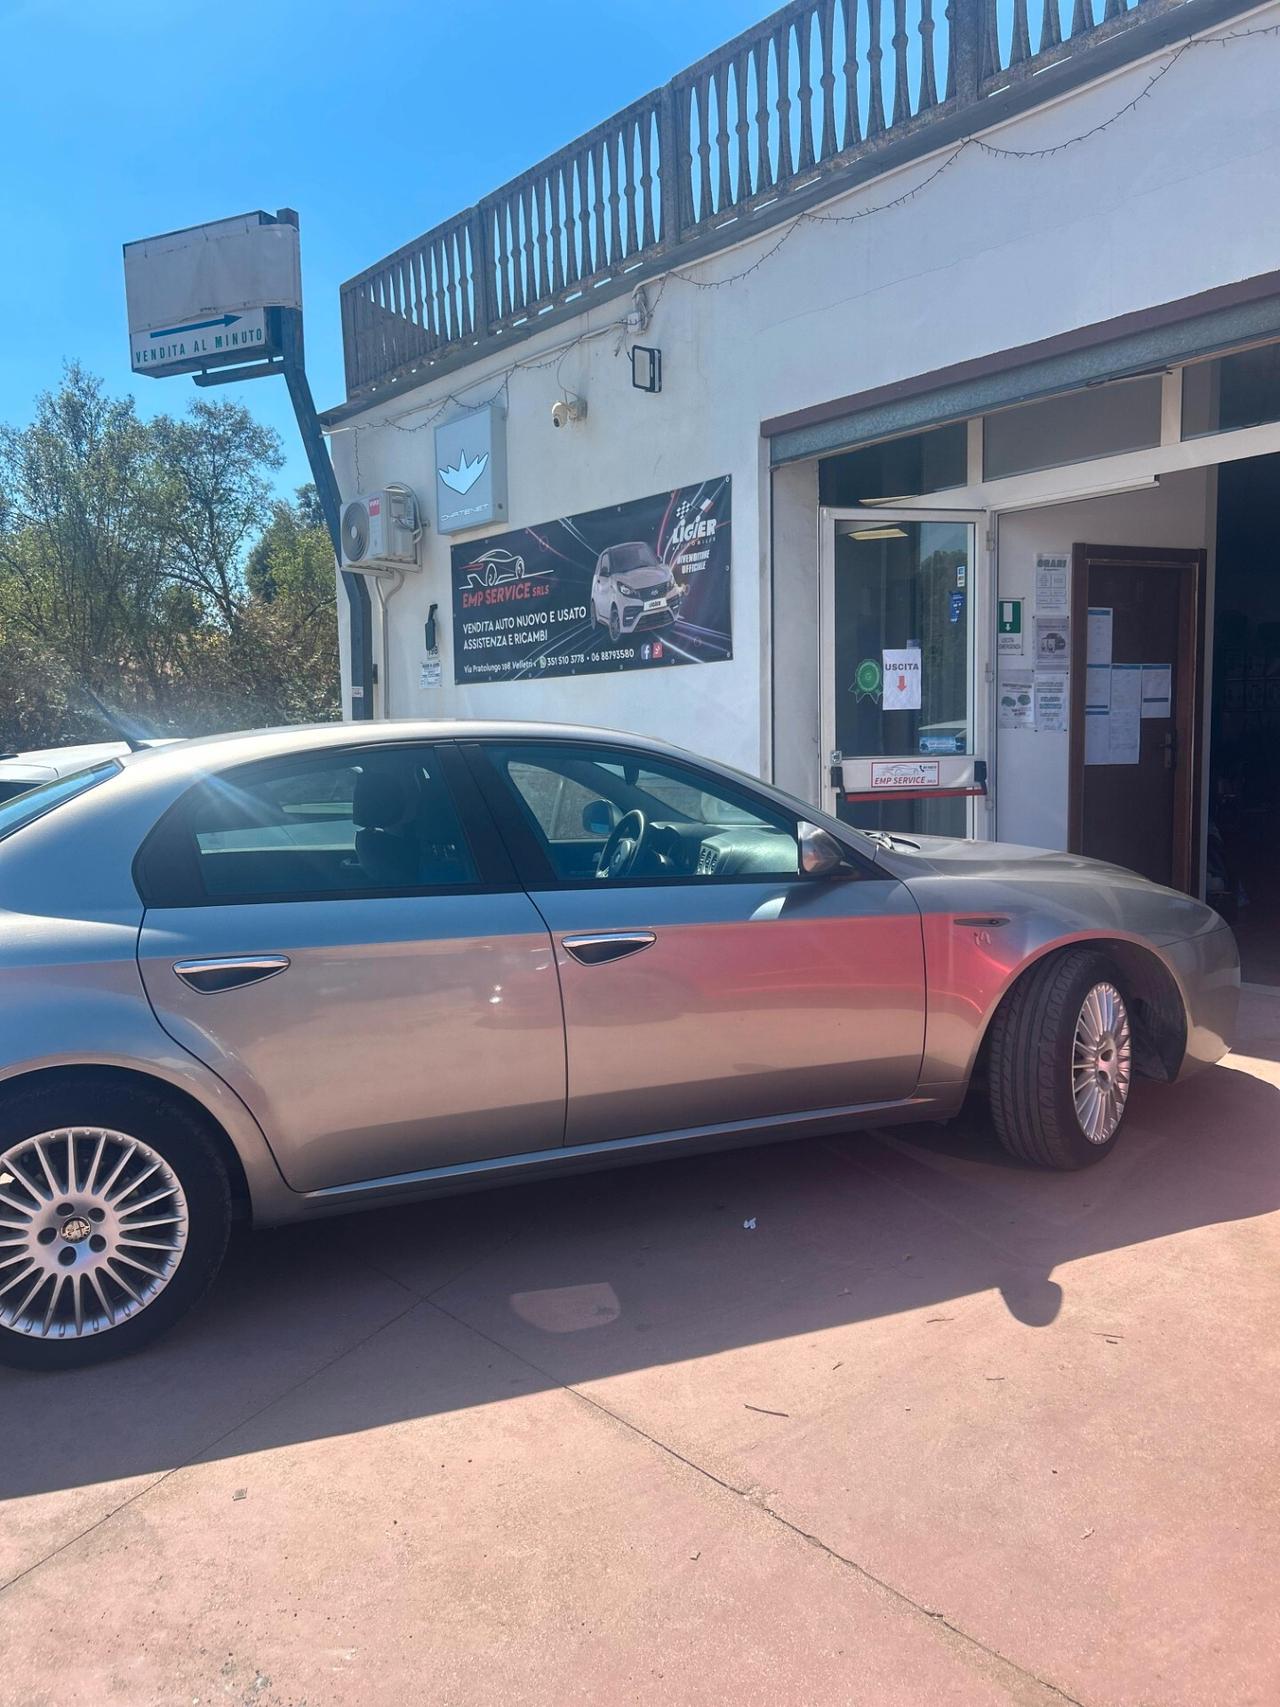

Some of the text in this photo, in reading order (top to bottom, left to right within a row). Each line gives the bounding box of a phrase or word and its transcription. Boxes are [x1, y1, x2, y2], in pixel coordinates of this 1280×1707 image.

[136, 328, 263, 363] VENDITA AL MINUTO
[672, 518, 717, 544] LIGIER
[462, 582, 550, 608] EMP SERVICE SRLS
[462, 606, 586, 634] VENDITA AUTO NUOVO E USATO
[463, 629, 548, 650] ASSISTENZA E RICAMBI
[463, 664, 472, 673] Via
[472, 662, 501, 673] Pratolungo
[547, 657, 558, 666] 351
[558, 656, 569, 665] 510
[570, 654, 585, 664] 3778
[591, 652, 600, 662] 06
[600, 648, 635, 661] 88793580
[885, 663, 919, 671] USCITA
[874, 777, 892, 785] EMP
[893, 776, 926, 784] SERVICE
